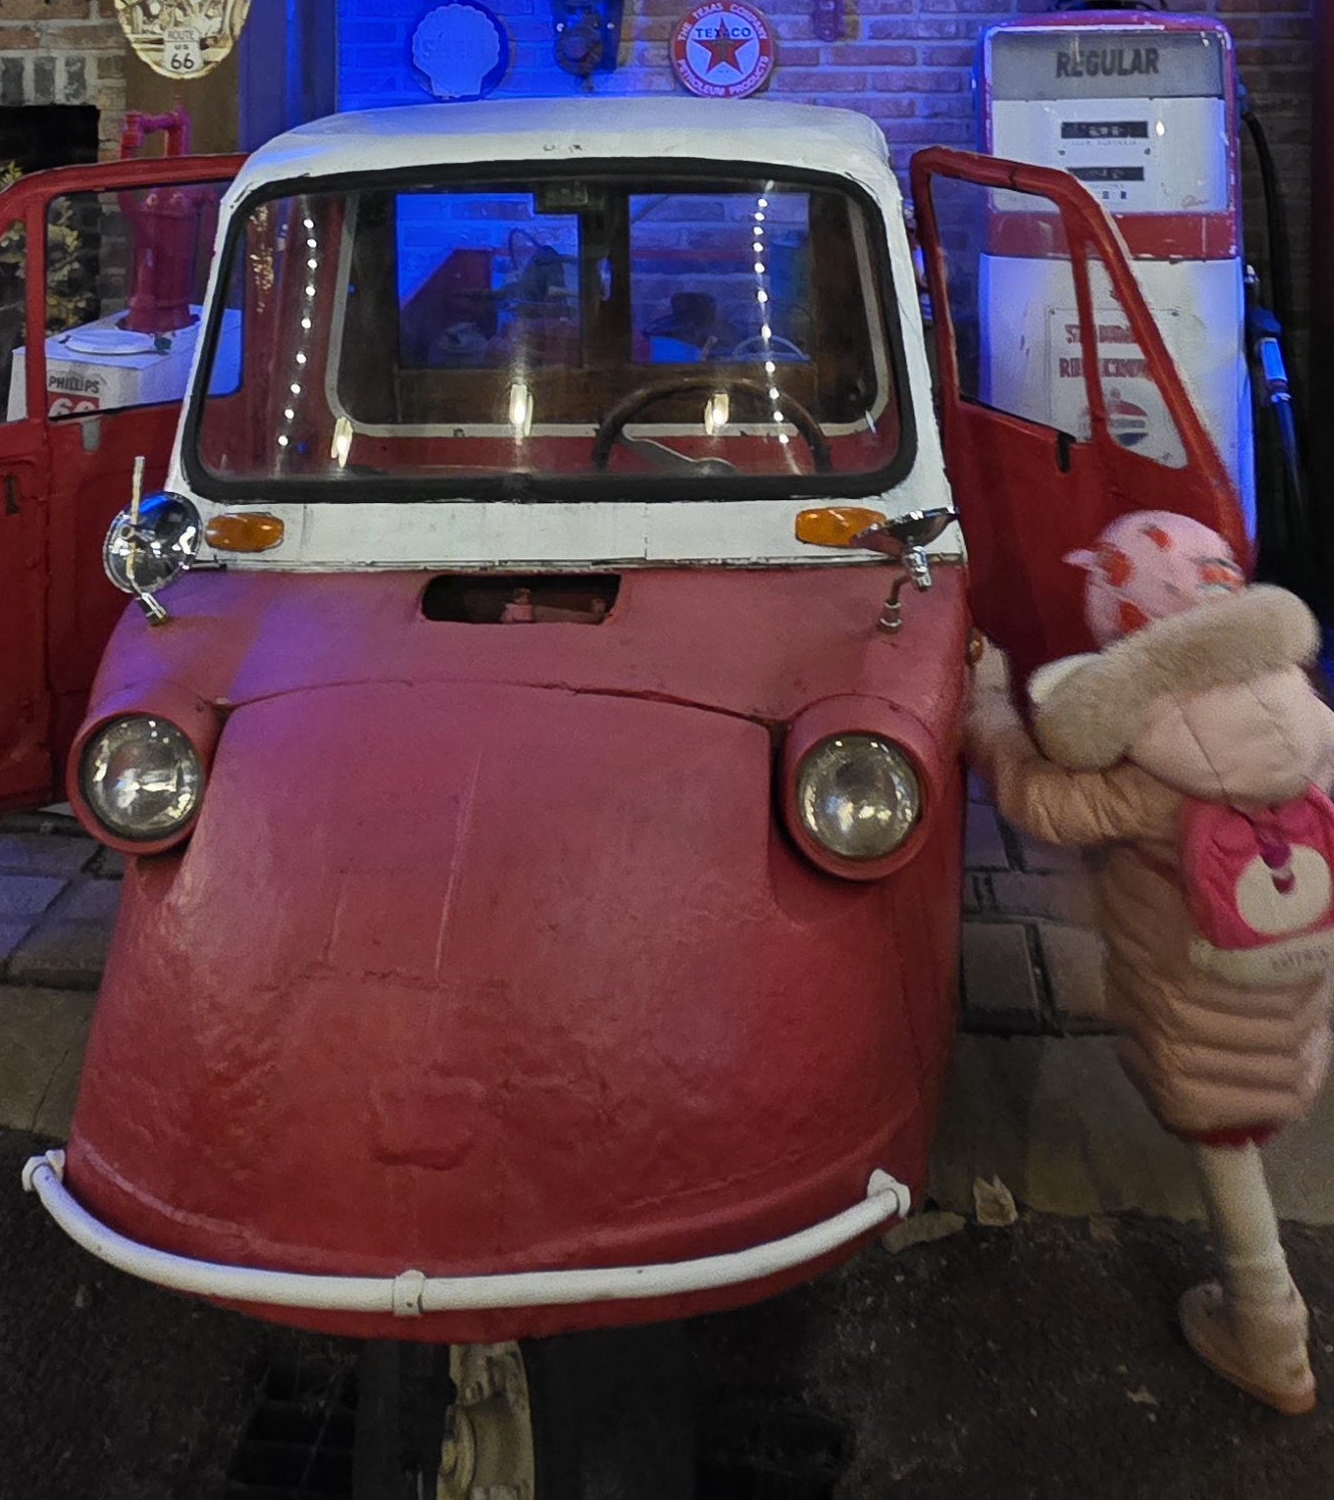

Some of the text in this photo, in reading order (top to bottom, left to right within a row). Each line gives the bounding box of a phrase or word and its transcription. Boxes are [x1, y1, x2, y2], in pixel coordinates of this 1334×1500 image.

[677, 3, 768, 41] THE TEXAS COMPANY
[695, 27, 752, 38] TEXACO
[167, 30, 195, 40] ROUTE
[170, 52, 195, 70] 66
[1055, 47, 1160, 79] REGULAR
[676, 55, 770, 96] PETROLEUM PRODUCTS
